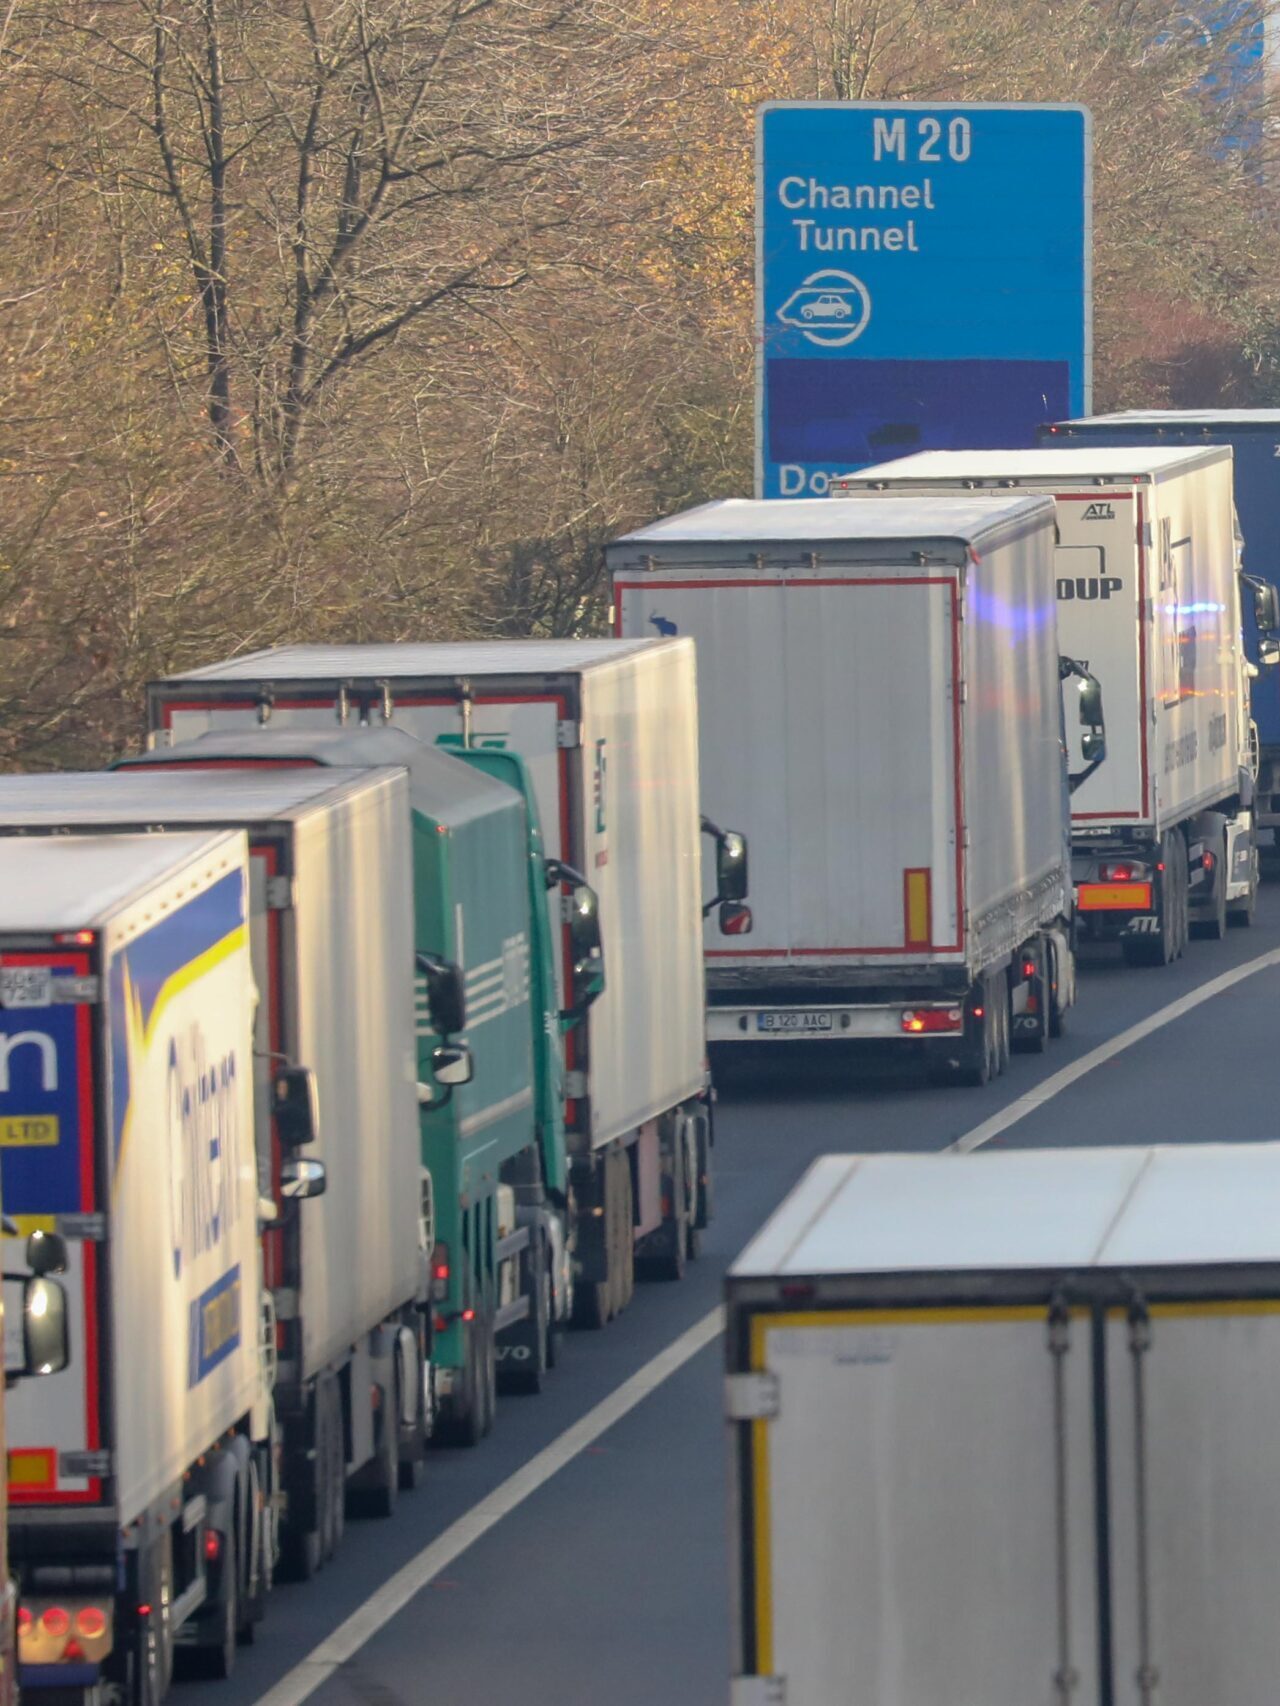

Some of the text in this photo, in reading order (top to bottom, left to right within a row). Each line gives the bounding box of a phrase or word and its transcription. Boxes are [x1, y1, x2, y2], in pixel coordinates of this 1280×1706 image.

[779, 176, 935, 209] Channel
[792, 219, 919, 251] Tunnel
[780, 464, 838, 495] Do
[7, 1121, 51, 1139] LTD
